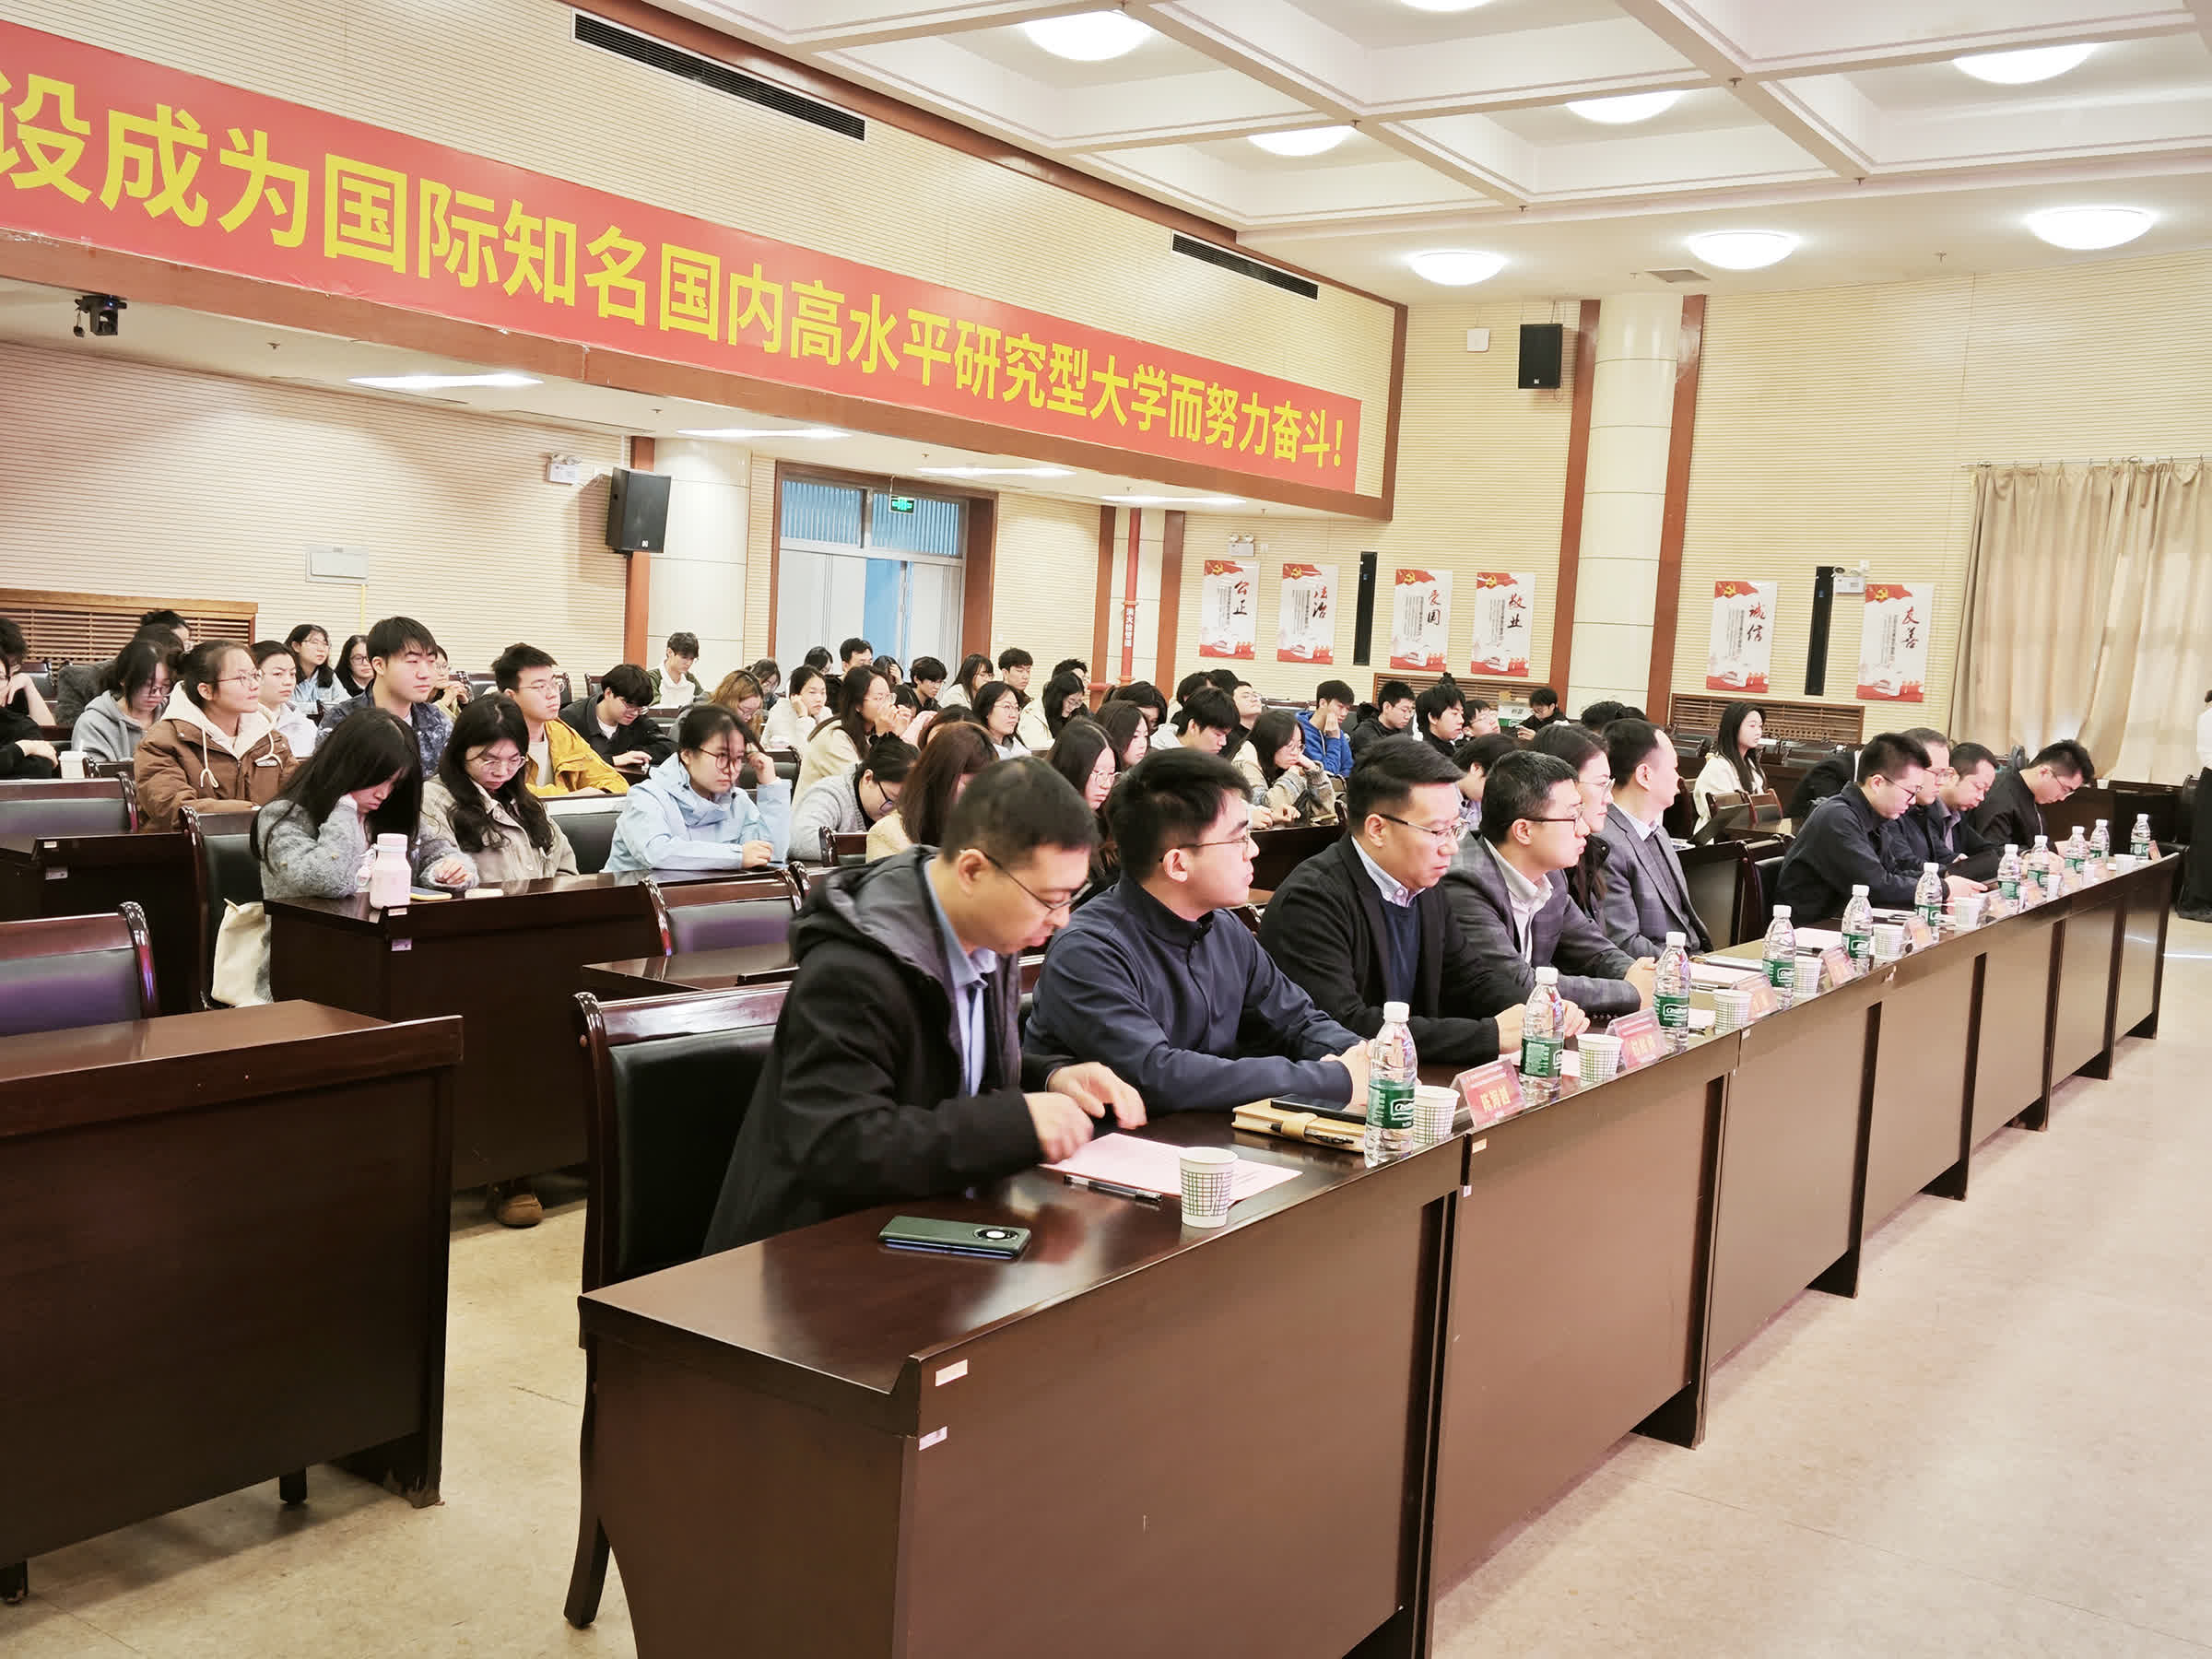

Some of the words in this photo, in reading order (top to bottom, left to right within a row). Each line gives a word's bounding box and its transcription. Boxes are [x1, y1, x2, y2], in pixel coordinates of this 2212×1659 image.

[0, 73, 1344, 468] 设成为国际知名国内高水平研究型大学而努力奋斗！
[1232, 581, 1250, 616] 公正
[1312, 585, 1328, 618] 法治
[1427, 589, 1441, 626] 爱国
[1507, 593, 1527, 629] 敬业
[1747, 604, 1767, 643] 诚信
[1900, 606, 1921, 650] 友善
